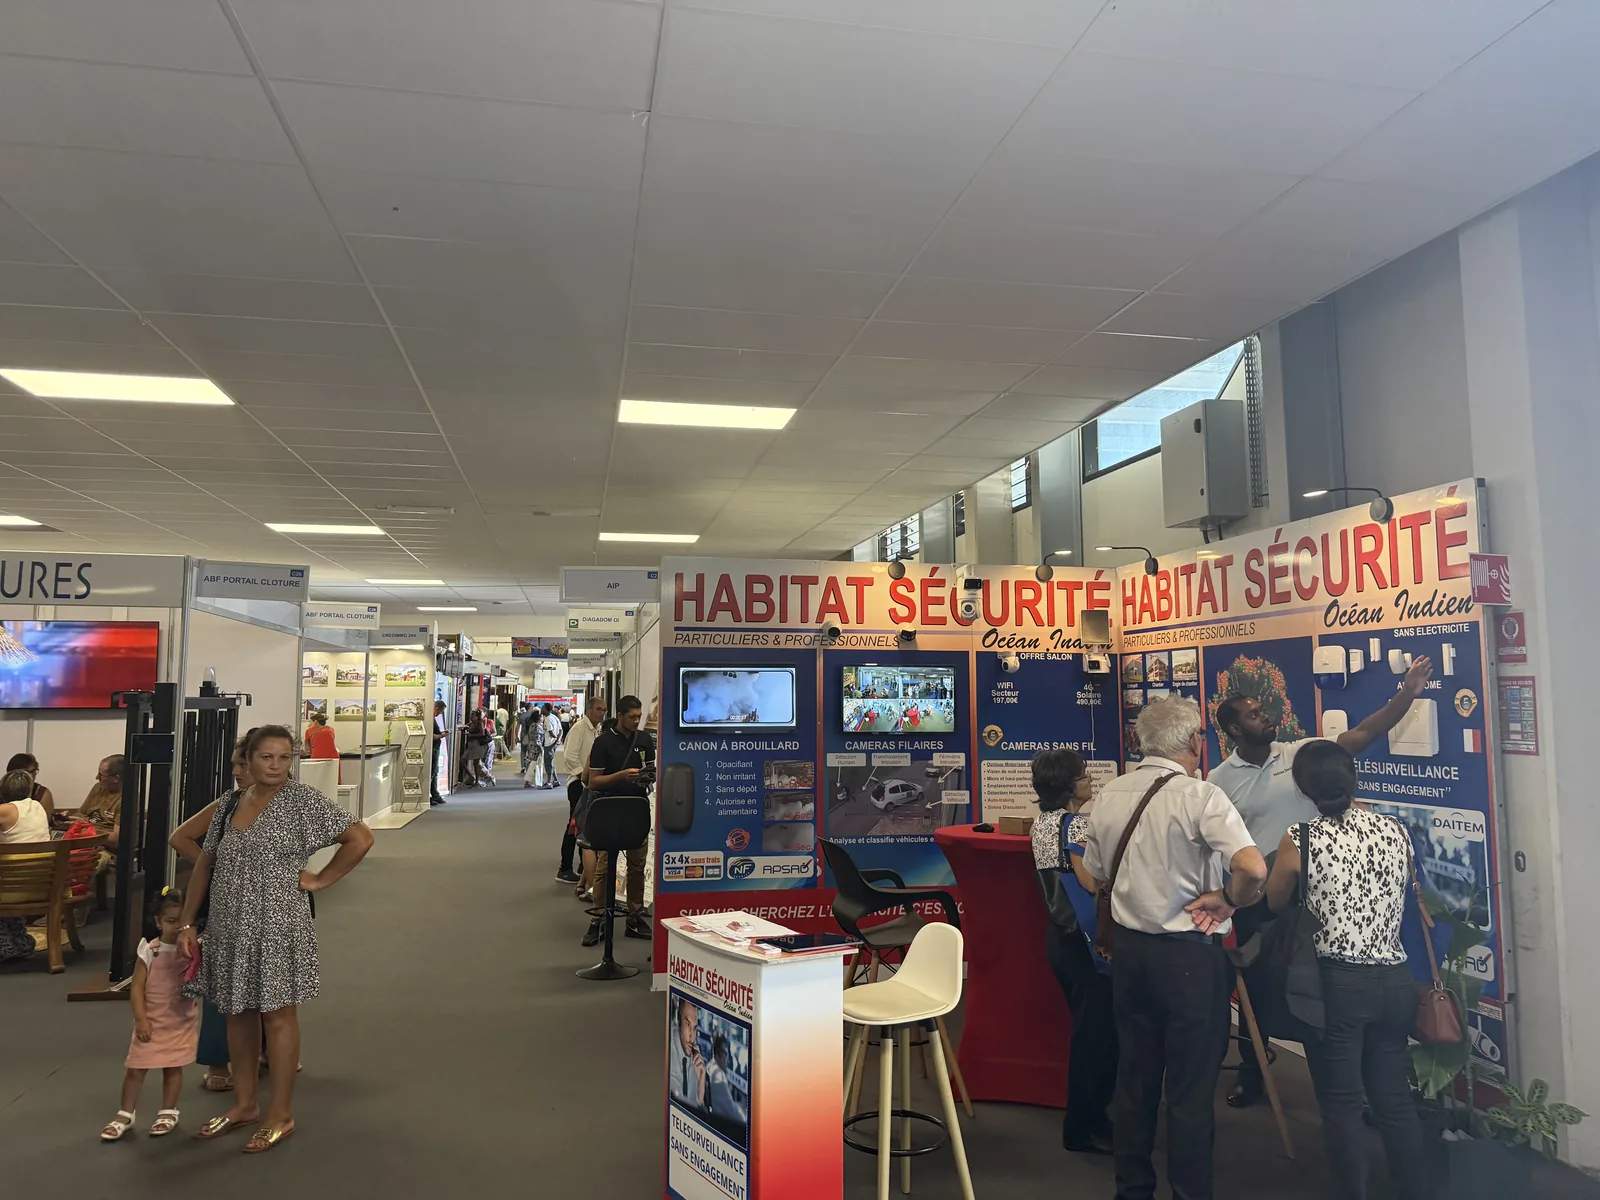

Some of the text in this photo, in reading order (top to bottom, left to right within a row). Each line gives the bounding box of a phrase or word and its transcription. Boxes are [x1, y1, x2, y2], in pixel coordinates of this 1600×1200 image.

[1121, 484, 1471, 627] HABITAT SÉCURITÉ
[0, 560, 93, 600] URES
[204, 575, 300, 588] ABF PORTAIL CLOTURE
[674, 572, 874, 625] HABITAT
[1323, 589, 1475, 627] Océan Indien
[1123, 622, 1256, 647] PARTICULIERS & PROFESSIONNELS
[1394, 623, 1470, 637] SANS ELECTRICITE
[674, 633, 900, 648] PARTICULIERS & PROFESSIONNELS
[982, 628, 1041, 649] Océan
[679, 740, 800, 750] CANON À BROUILLARD
[845, 740, 944, 750] CAMERAS FILAIRES
[1001, 742, 1096, 750] CAMERAS SANS FIL
[716, 760, 753, 769] Opacifiant
[1353, 758, 1459, 780] LÉSURVEILLANCE
[736, 785, 757, 794] dépôt
[1358, 781, 1380, 792] SANS
[1433, 816, 1484, 834] DAITEM
[664, 854, 676, 864] 3x
[678, 854, 690, 864] 4x
[734, 865, 751, 874] NF
[912, 902, 946, 915] C'ES
[670, 954, 753, 1010] HABITAT SÉCURITÉ
[672, 1114, 744, 1176] TELESURVEILLANCE
[671, 1136, 745, 1200] SANS ENGAGEMENT
